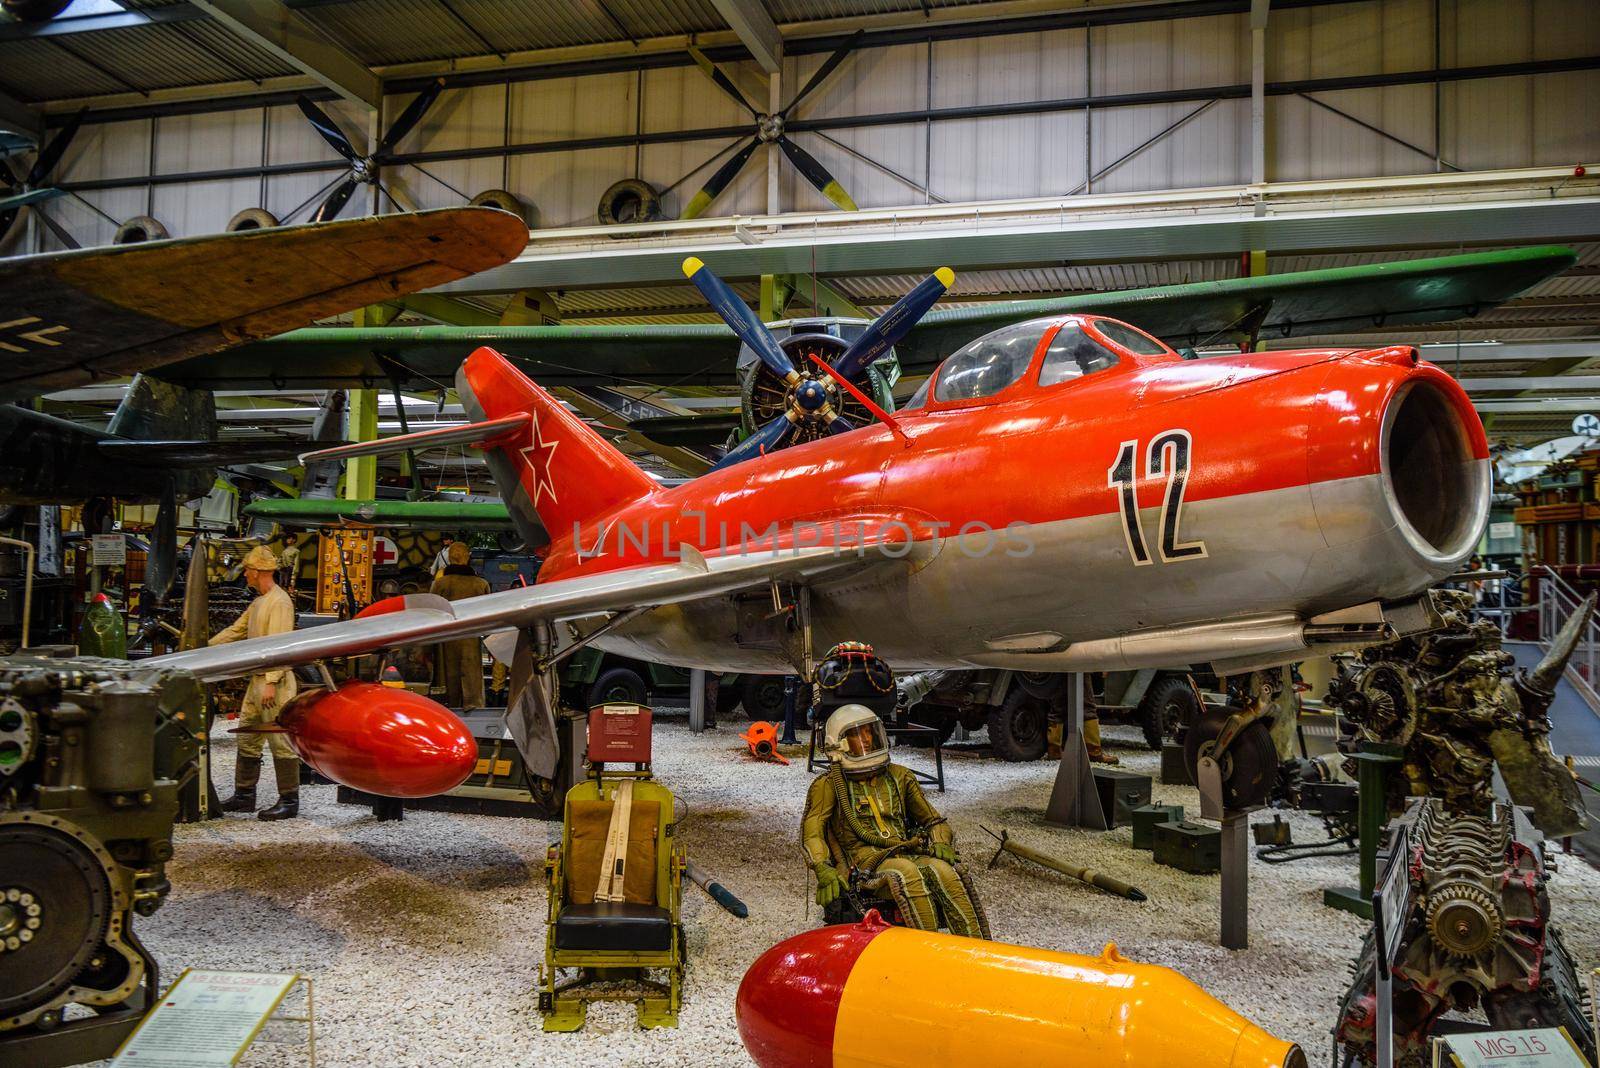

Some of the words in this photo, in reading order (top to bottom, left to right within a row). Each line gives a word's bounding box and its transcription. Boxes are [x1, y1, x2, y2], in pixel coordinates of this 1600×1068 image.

[1107, 428, 1209, 566] 12
[1473, 1037, 1517, 1056] MIG
[1518, 1035, 1547, 1053] 15
